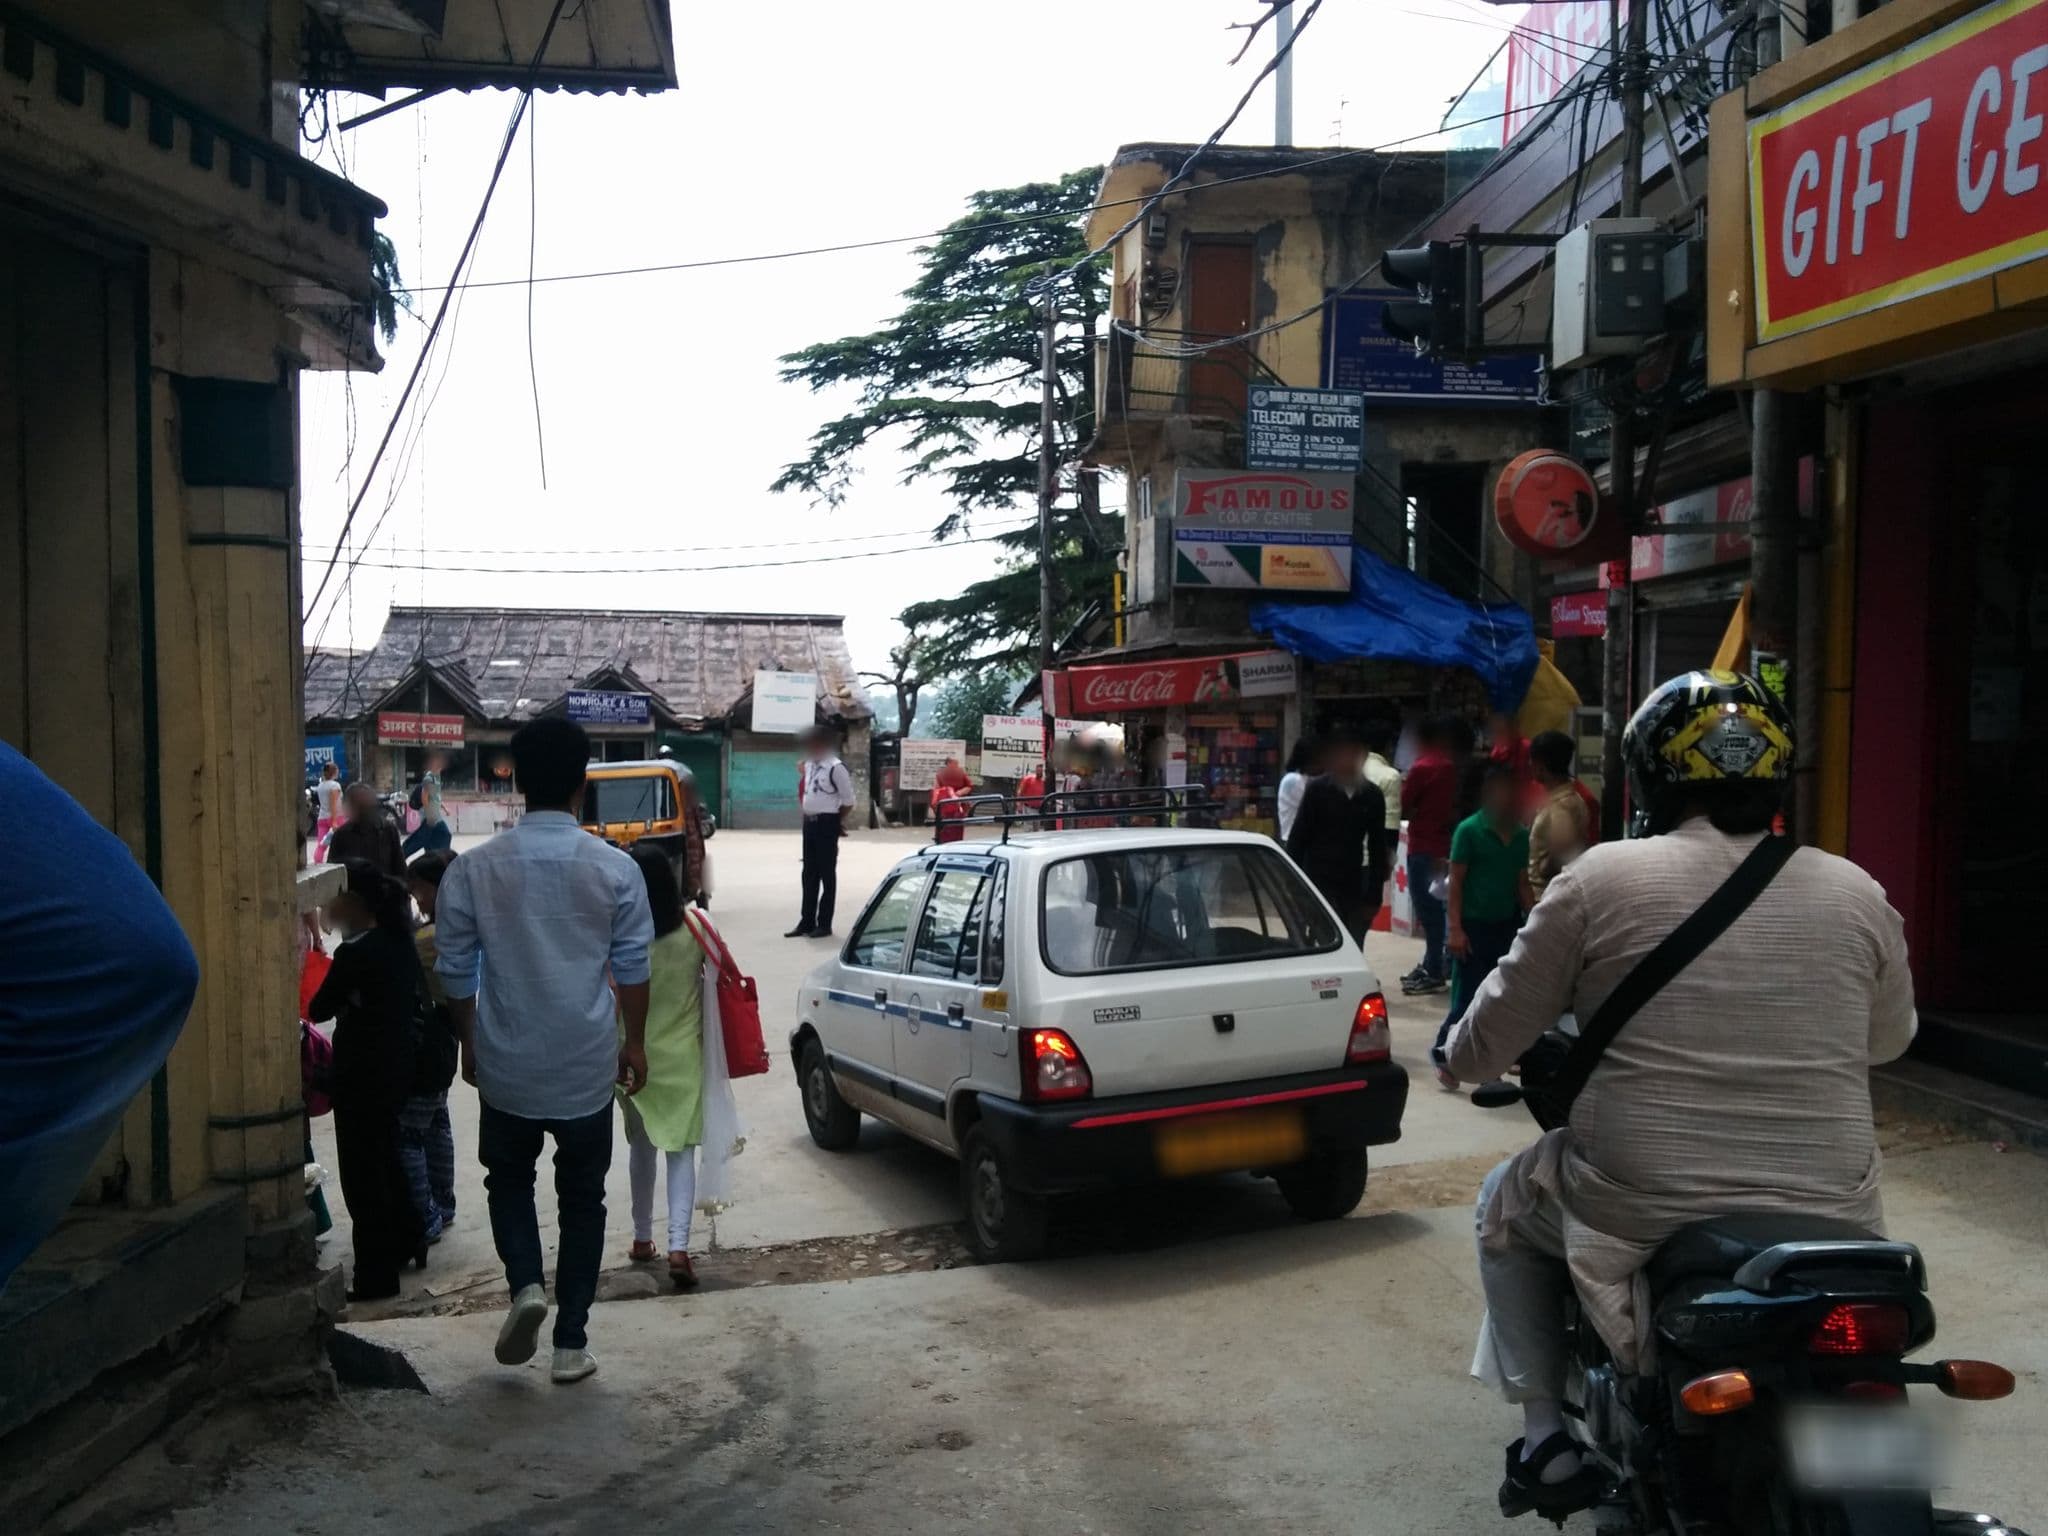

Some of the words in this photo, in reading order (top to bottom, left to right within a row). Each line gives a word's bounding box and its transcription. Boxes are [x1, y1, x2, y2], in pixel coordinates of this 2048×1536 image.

[1783, 97, 1932, 278] GIFT
[1957, 43, 2048, 215] CE
[1251, 409, 1305, 426] TELECOM
[1312, 413, 1360, 428] CENTRE
[1256, 432, 1277, 440] STD
[1279, 434, 1301, 442] PCO
[1323, 436, 1345, 444] PCO
[1184, 475, 1349, 516] FAMOUS
[1218, 511, 1259, 525] COLOR
[1263, 512, 1313, 526] CENTRE
[1284, 560, 1311, 569] Kodak
[1241, 663, 1294, 679] SHARMA
[1085, 671, 1178, 705] Coca-Cola
[569, 696, 617, 708] NOWROJEE
[619, 698, 626, 708] &
[380, 721, 417, 733] अमर
[1000, 717, 1016, 725] NO
[1020, 718, 1072, 728] SMONG
[1027, 741, 1044, 752] W
[1095, 1006, 1139, 1016] MARUTI
[1095, 1013, 1140, 1023] SUZUKI
